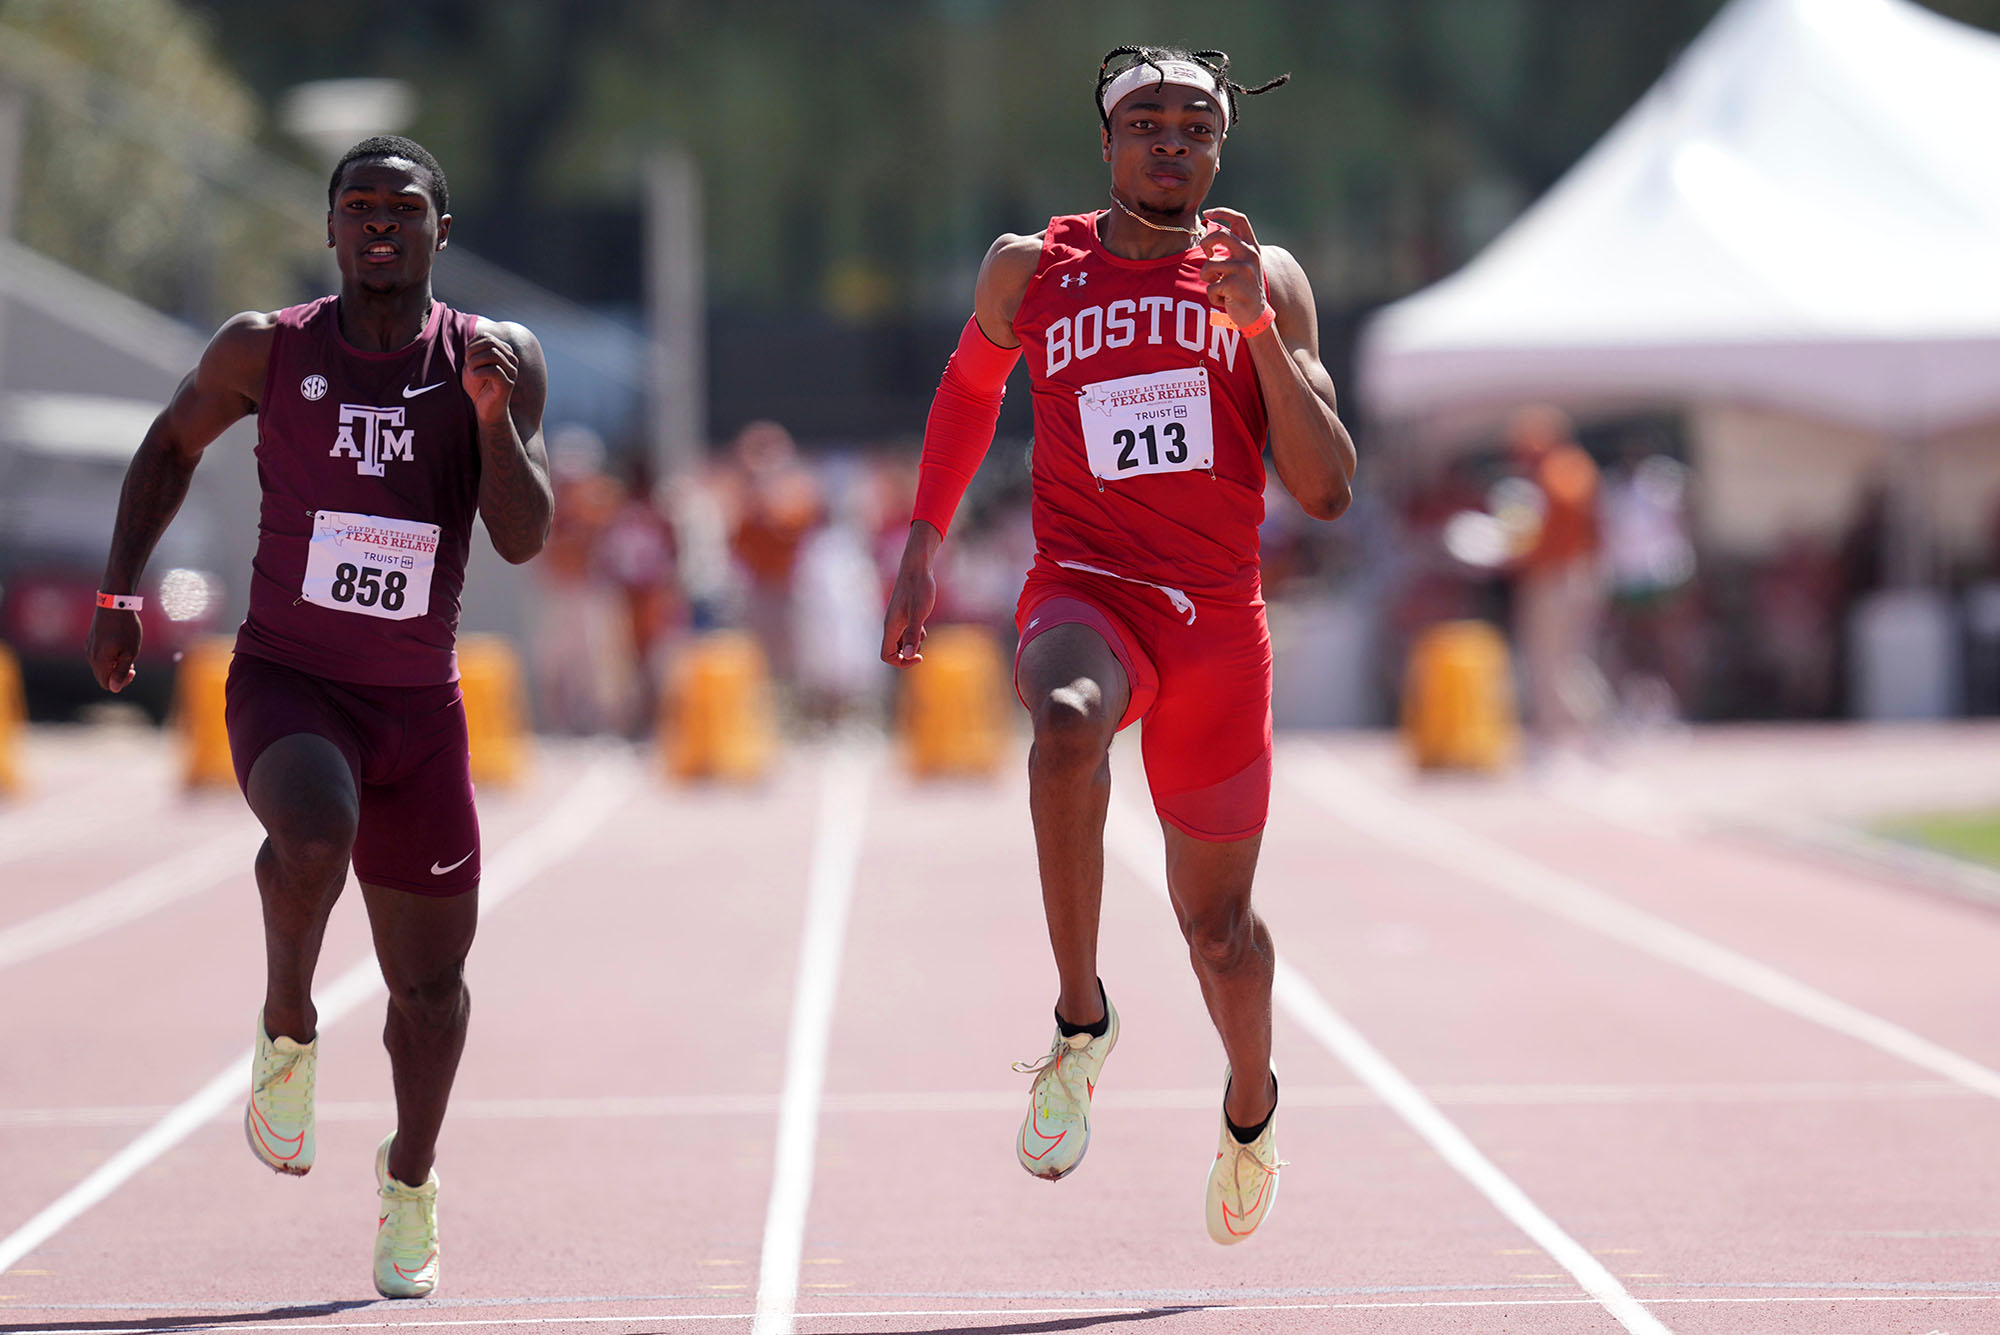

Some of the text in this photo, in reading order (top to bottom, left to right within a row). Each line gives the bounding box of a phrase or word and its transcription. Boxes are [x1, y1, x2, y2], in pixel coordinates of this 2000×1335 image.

[1045, 296, 1240, 378] BOSTON
[303, 377, 325, 398] SEC
[1110, 380, 1206, 398] CLYDE LITTLEFIELD
[1110, 392, 1155, 407] TEXAS
[1158, 386, 1207, 400] RELAYS
[1135, 408, 1171, 420] TRUIST
[1113, 422, 1188, 471] 213
[345, 531, 435, 553] TEXAS RELAYS
[347, 525, 437, 543] CLYDE LITTLEFIELD
[364, 552, 399, 564] TRUIST
[331, 562, 407, 611] 858
